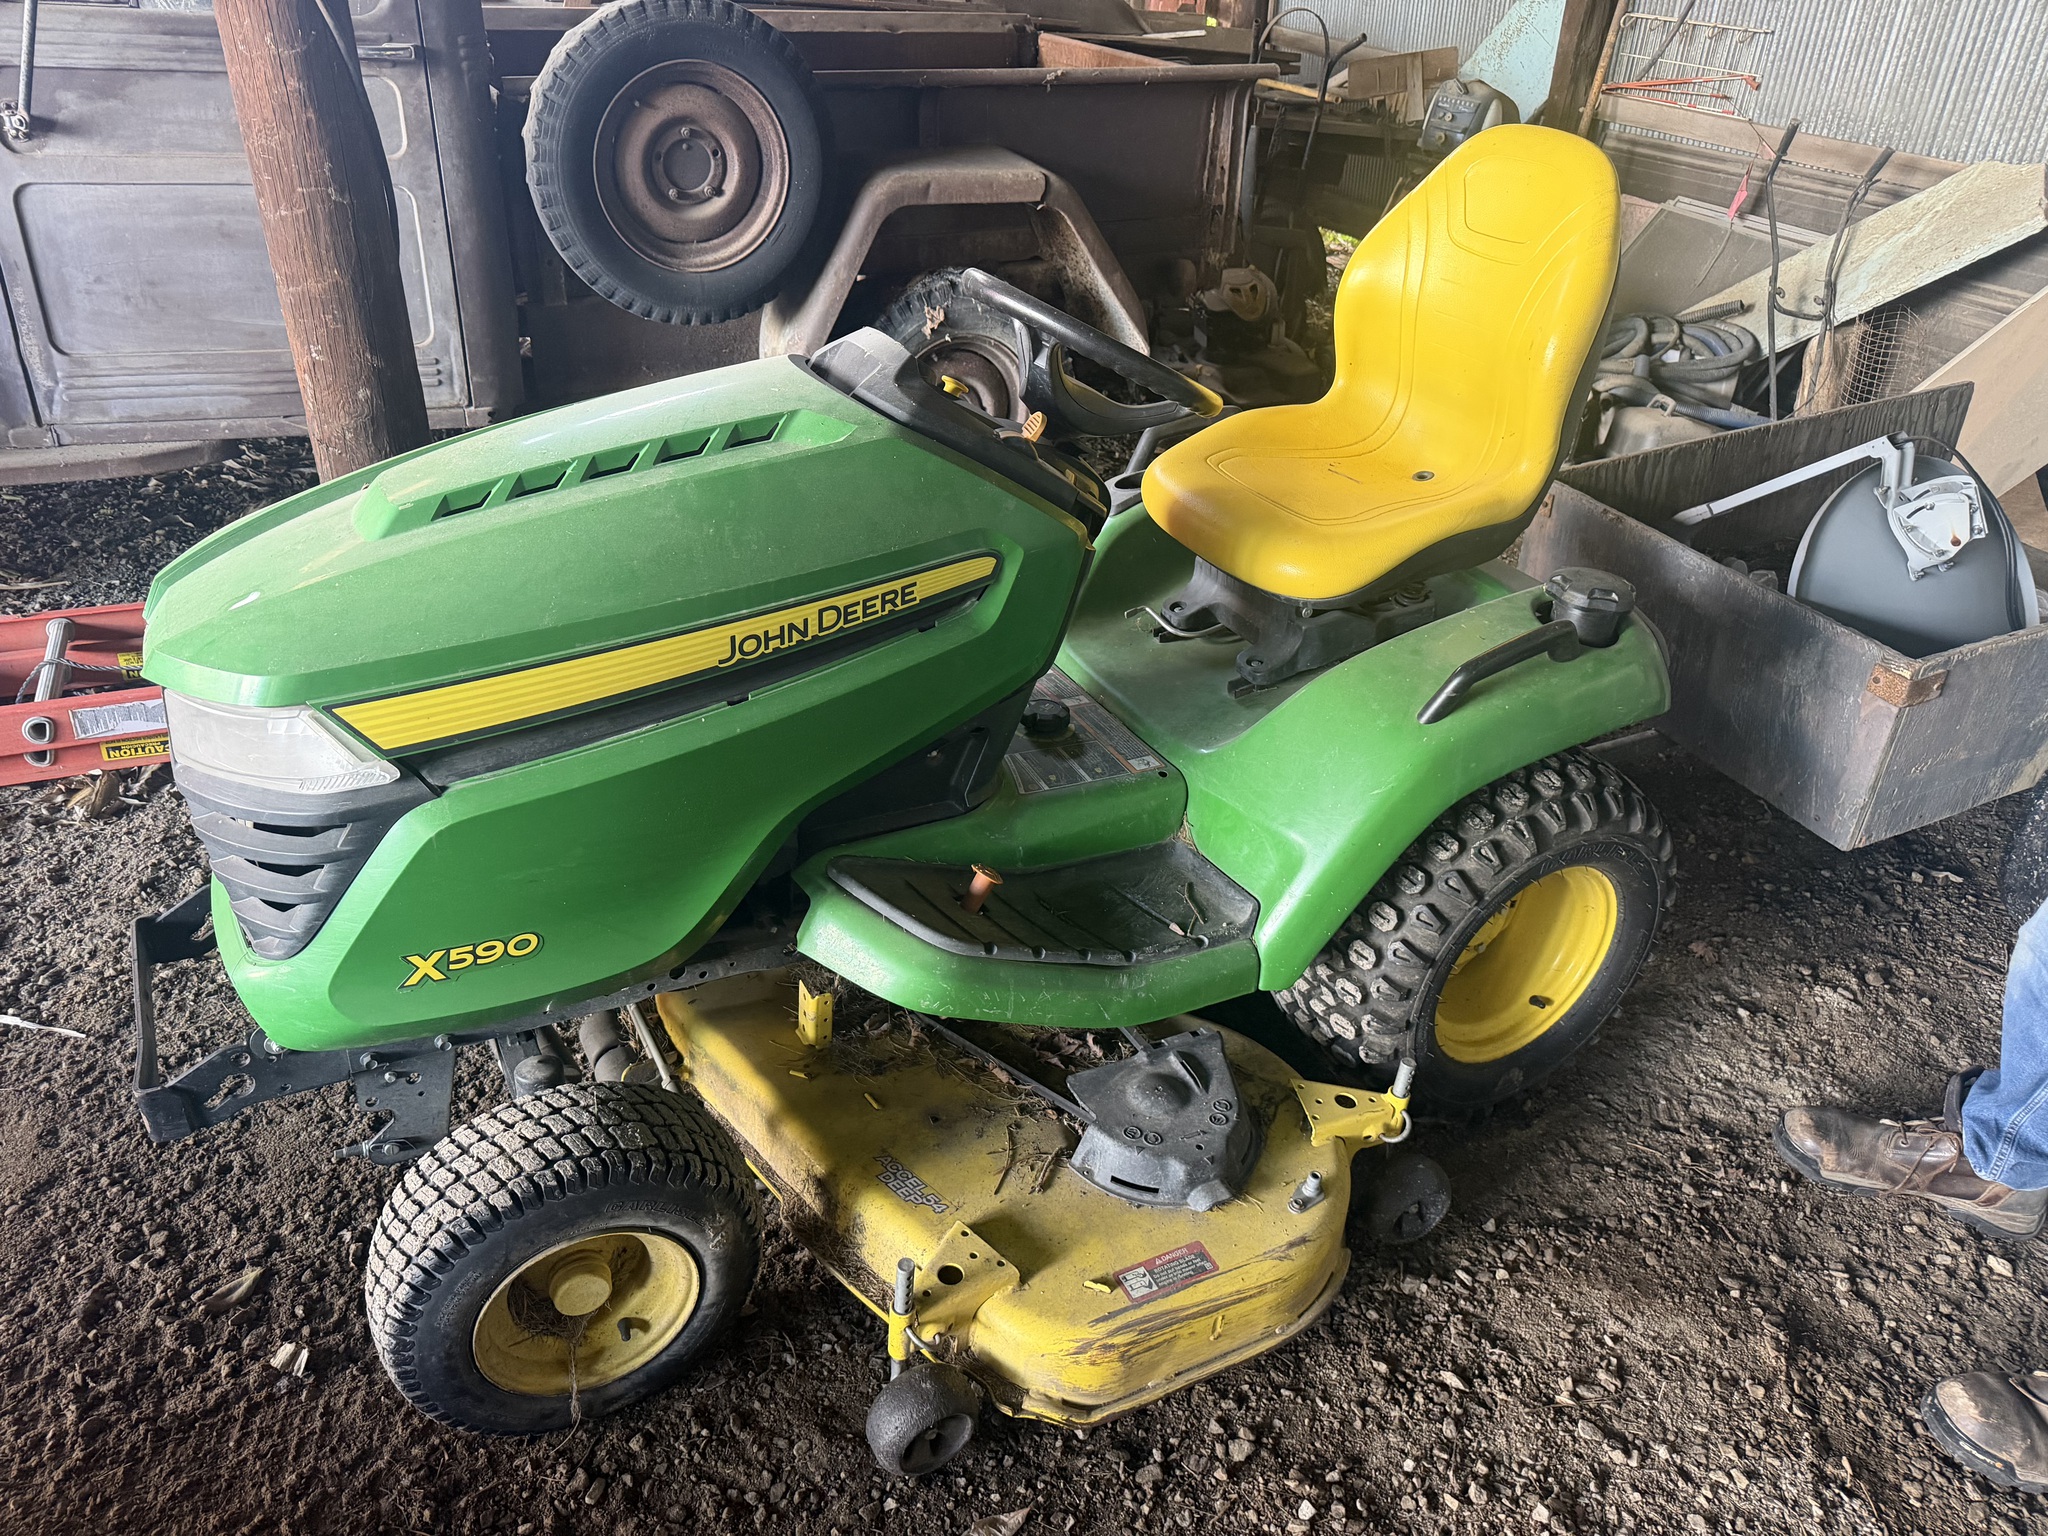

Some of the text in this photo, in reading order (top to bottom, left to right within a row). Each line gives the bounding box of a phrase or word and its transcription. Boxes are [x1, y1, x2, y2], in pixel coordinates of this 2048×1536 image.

[718, 581, 917, 665] JOHN DEERE
[398, 931, 540, 988] X590
[873, 1155, 950, 1214] ACCEL 54
[876, 1171, 924, 1205] DEEP
[1161, 1248, 1188, 1261] DANGER
